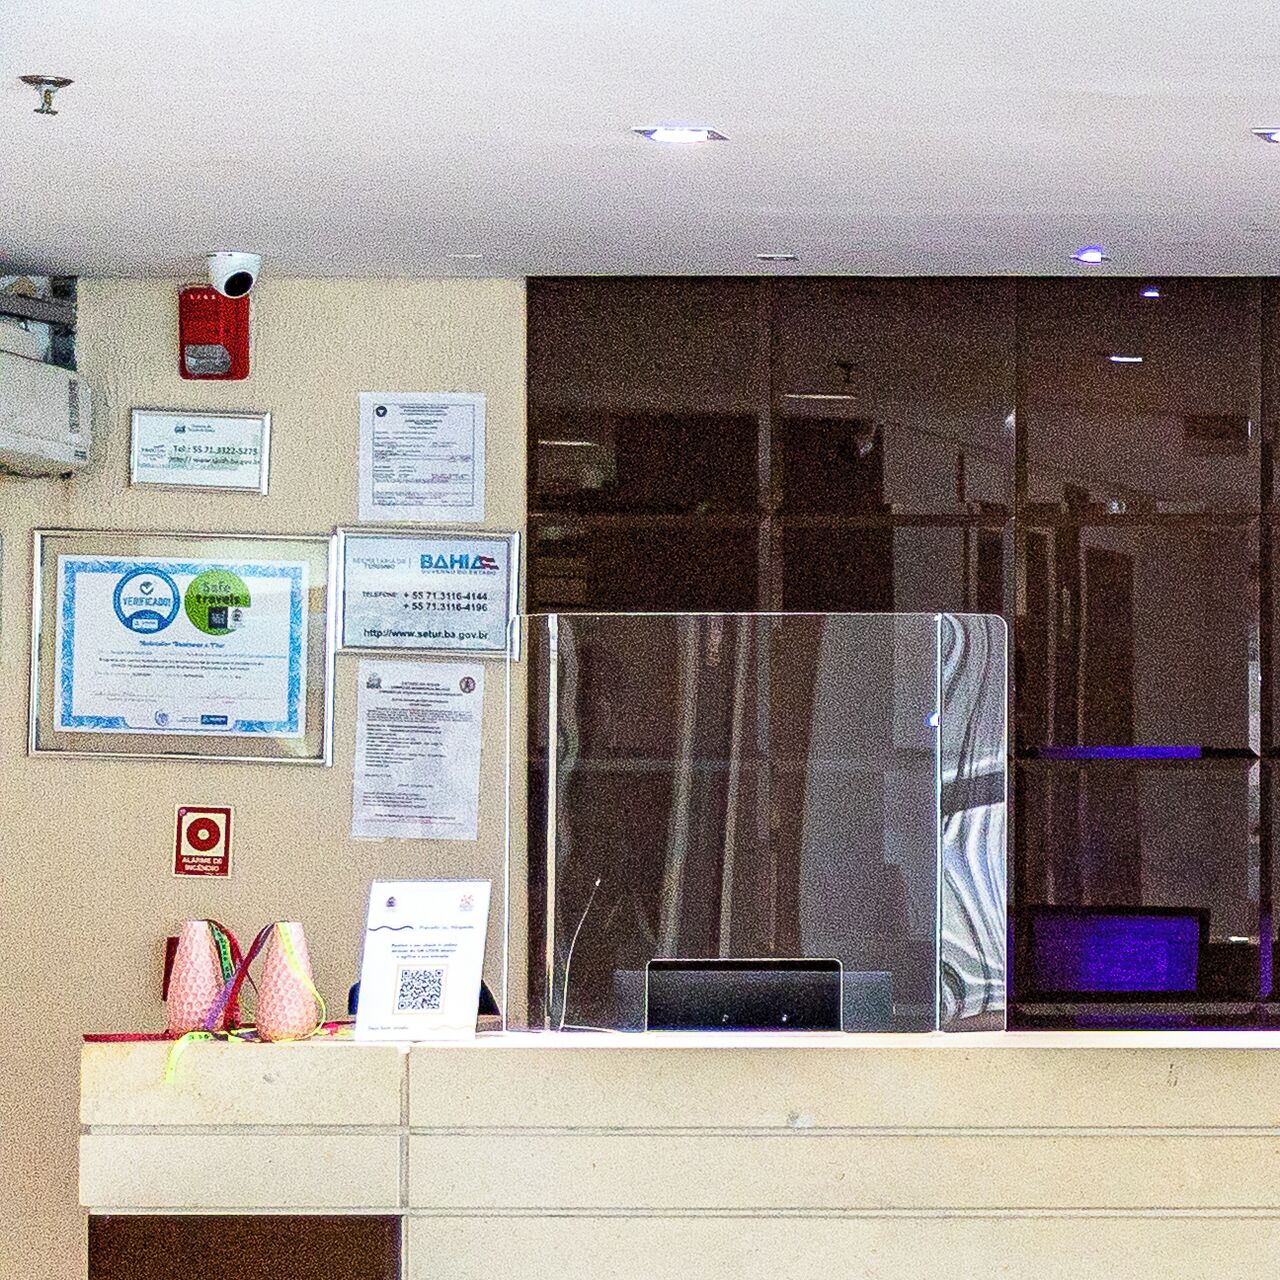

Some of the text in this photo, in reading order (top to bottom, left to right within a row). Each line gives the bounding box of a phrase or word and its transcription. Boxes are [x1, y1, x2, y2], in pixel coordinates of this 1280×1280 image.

[420, 554, 484, 570] BAHIA
[202, 581, 232, 594] Safe
[195, 593, 241, 606] travels
